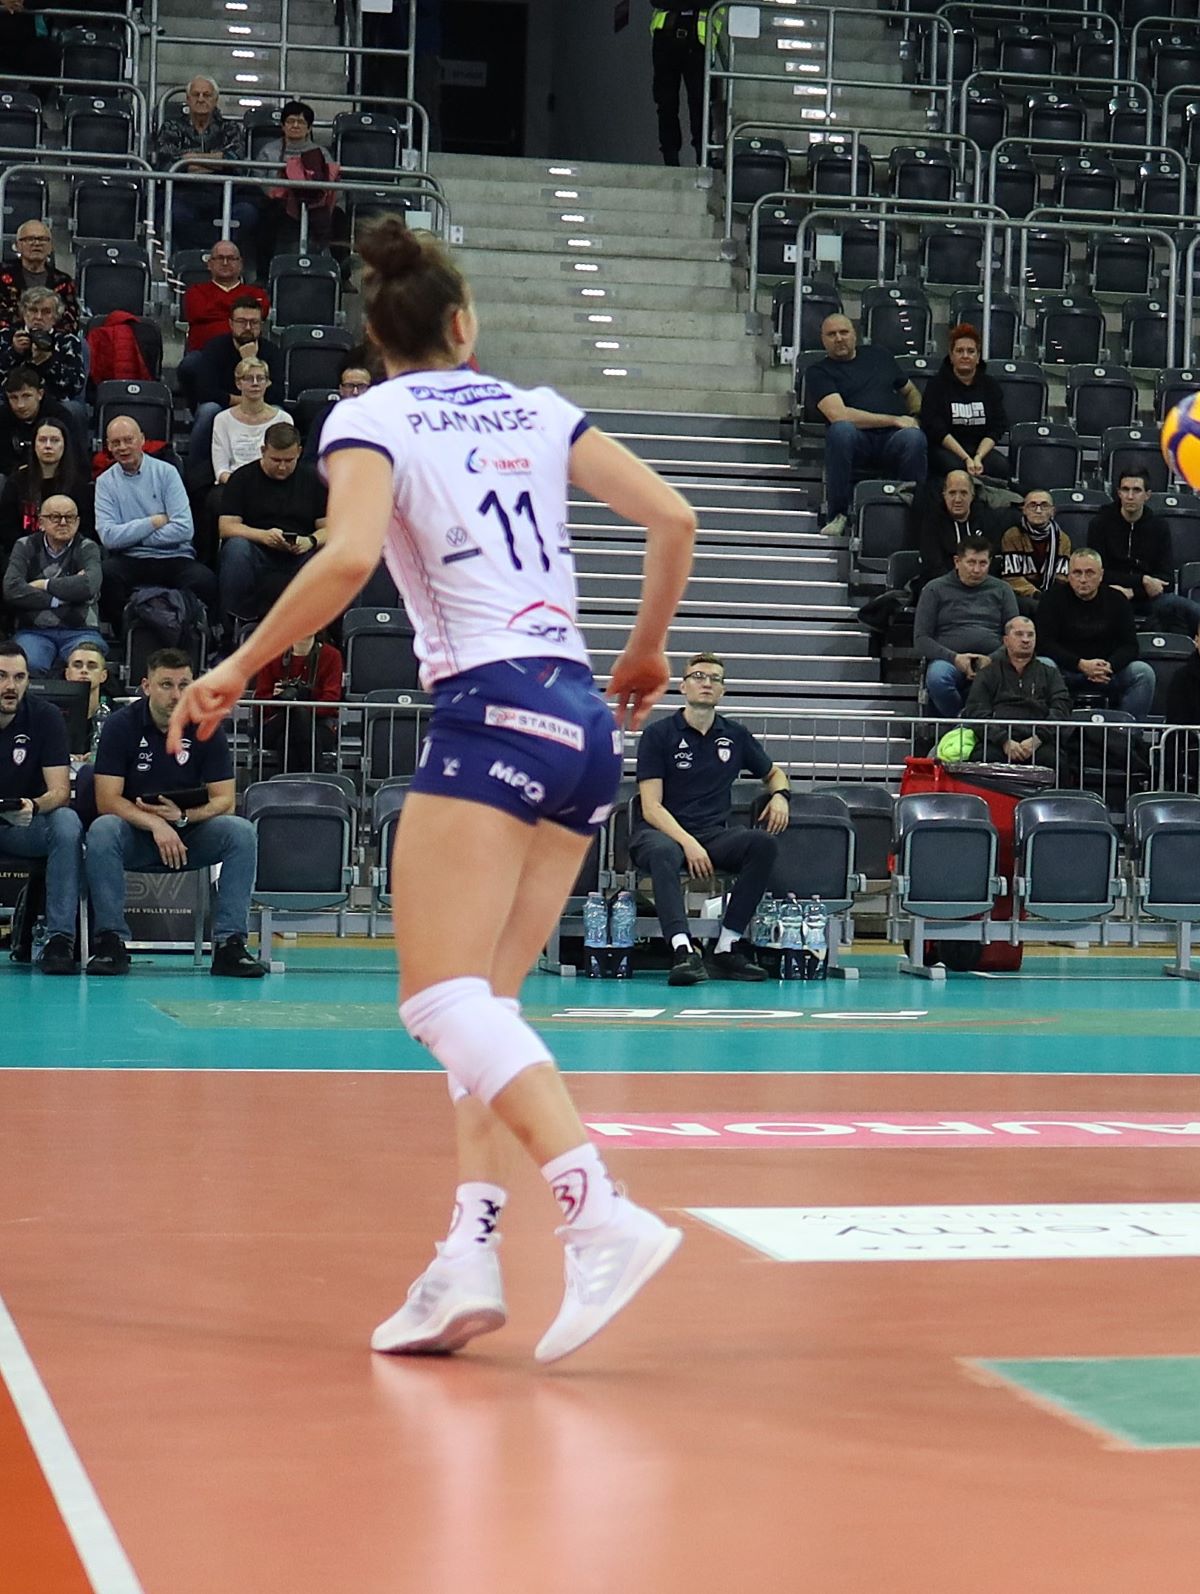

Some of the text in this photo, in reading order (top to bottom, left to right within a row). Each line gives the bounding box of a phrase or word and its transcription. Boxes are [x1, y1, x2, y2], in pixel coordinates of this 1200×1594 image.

[478, 490, 550, 572] 11
[517, 713, 579, 740] STASIAK
[552, 1008, 929, 1021] PGE
